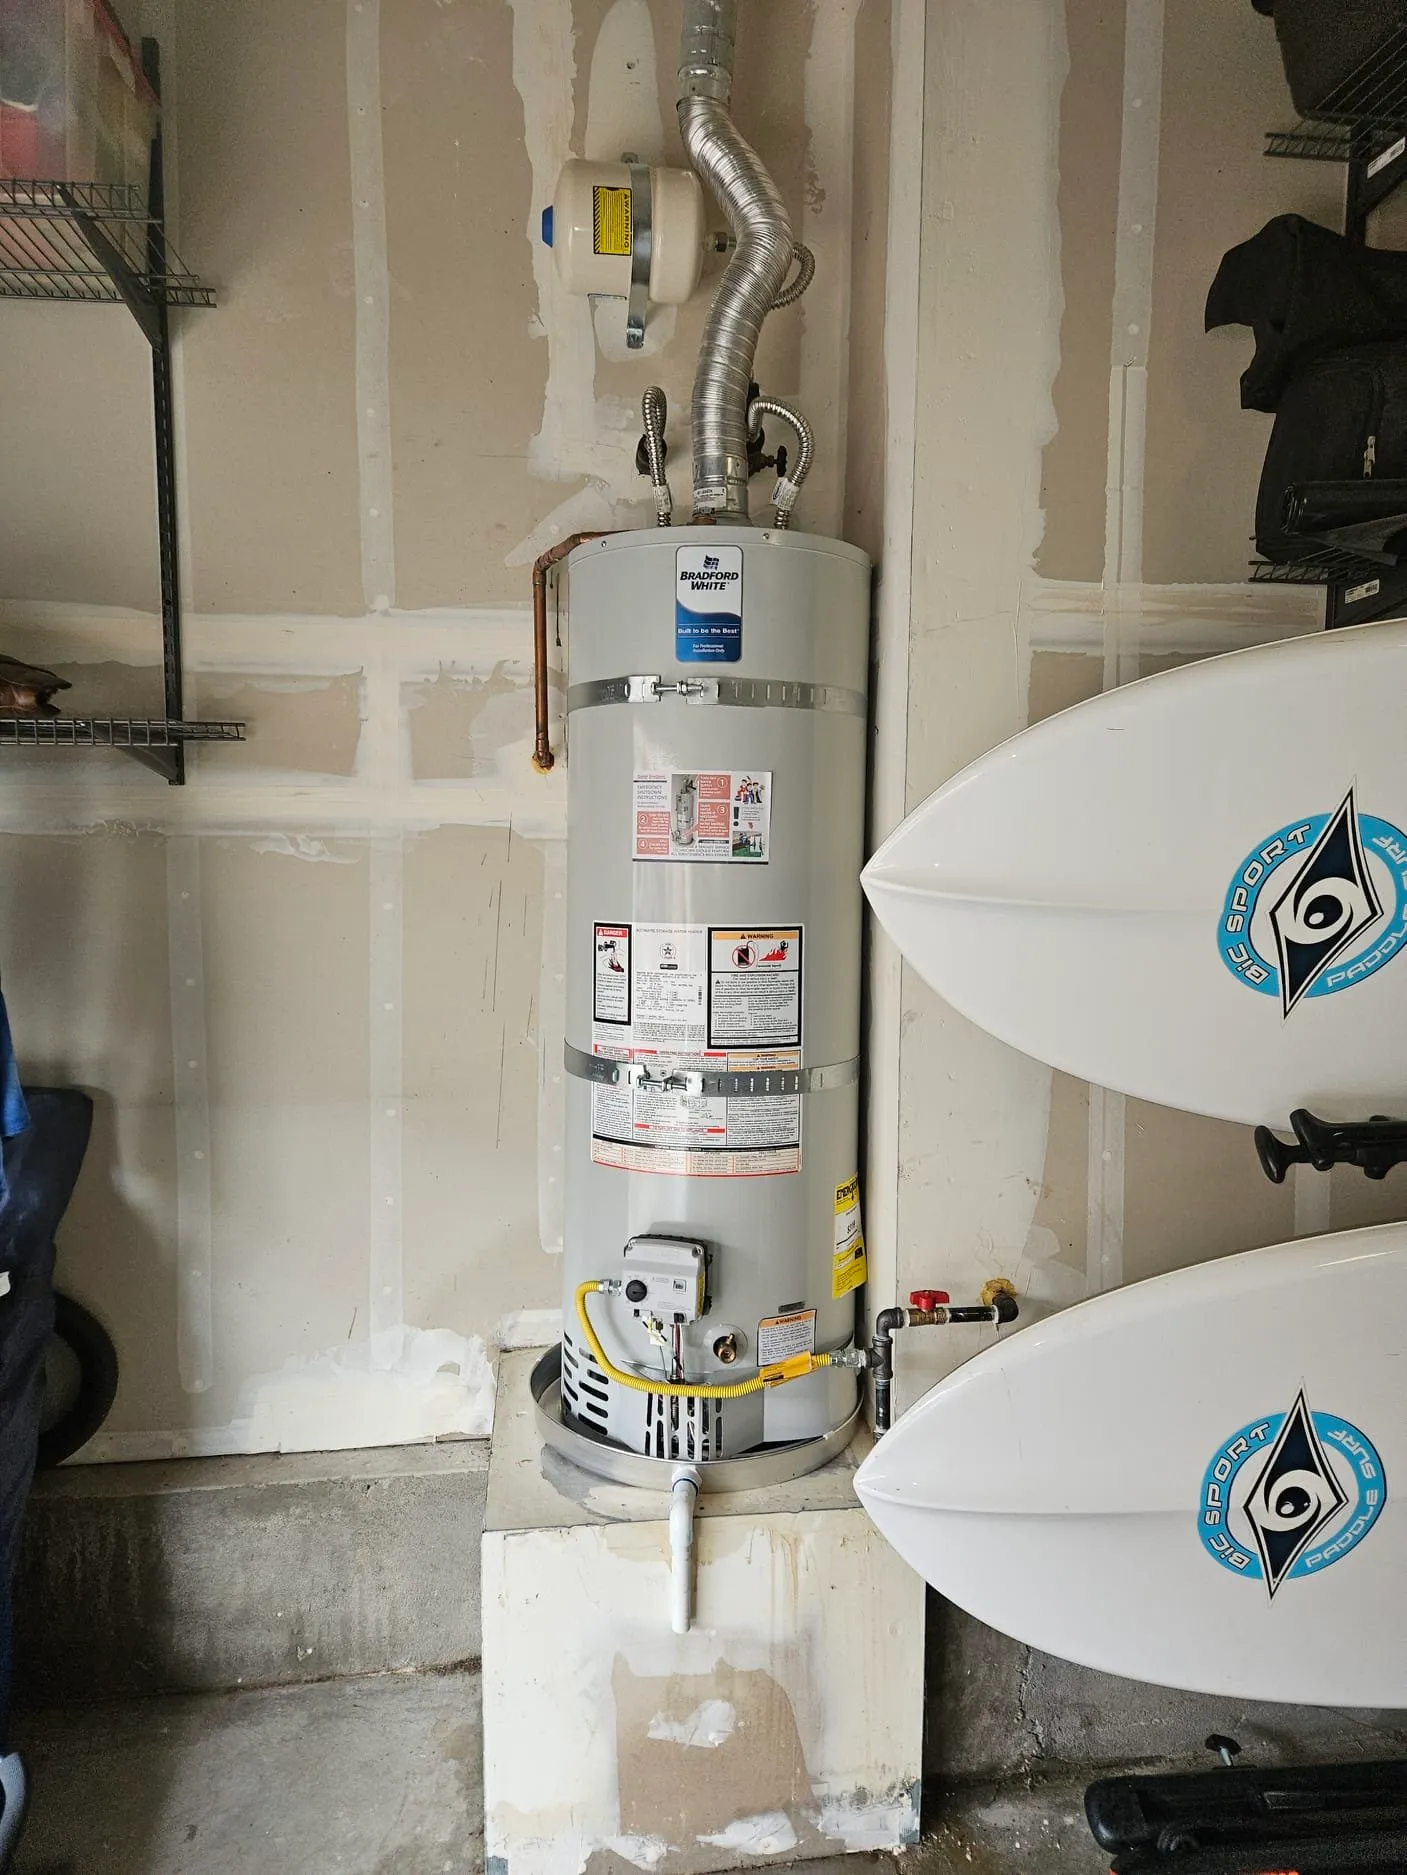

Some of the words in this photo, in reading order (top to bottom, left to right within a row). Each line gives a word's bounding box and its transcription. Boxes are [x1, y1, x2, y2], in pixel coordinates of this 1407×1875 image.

[680, 571, 739, 580] BRADFORD
[691, 581, 726, 590] WHITE
[1226, 824, 1311, 933] SPORT
[780, 1316, 802, 1324] WARNING
[1204, 1422, 1270, 1526] SPORT
[1328, 1429, 1376, 1479] SURF
[1305, 1489, 1379, 1568] PADDLE
